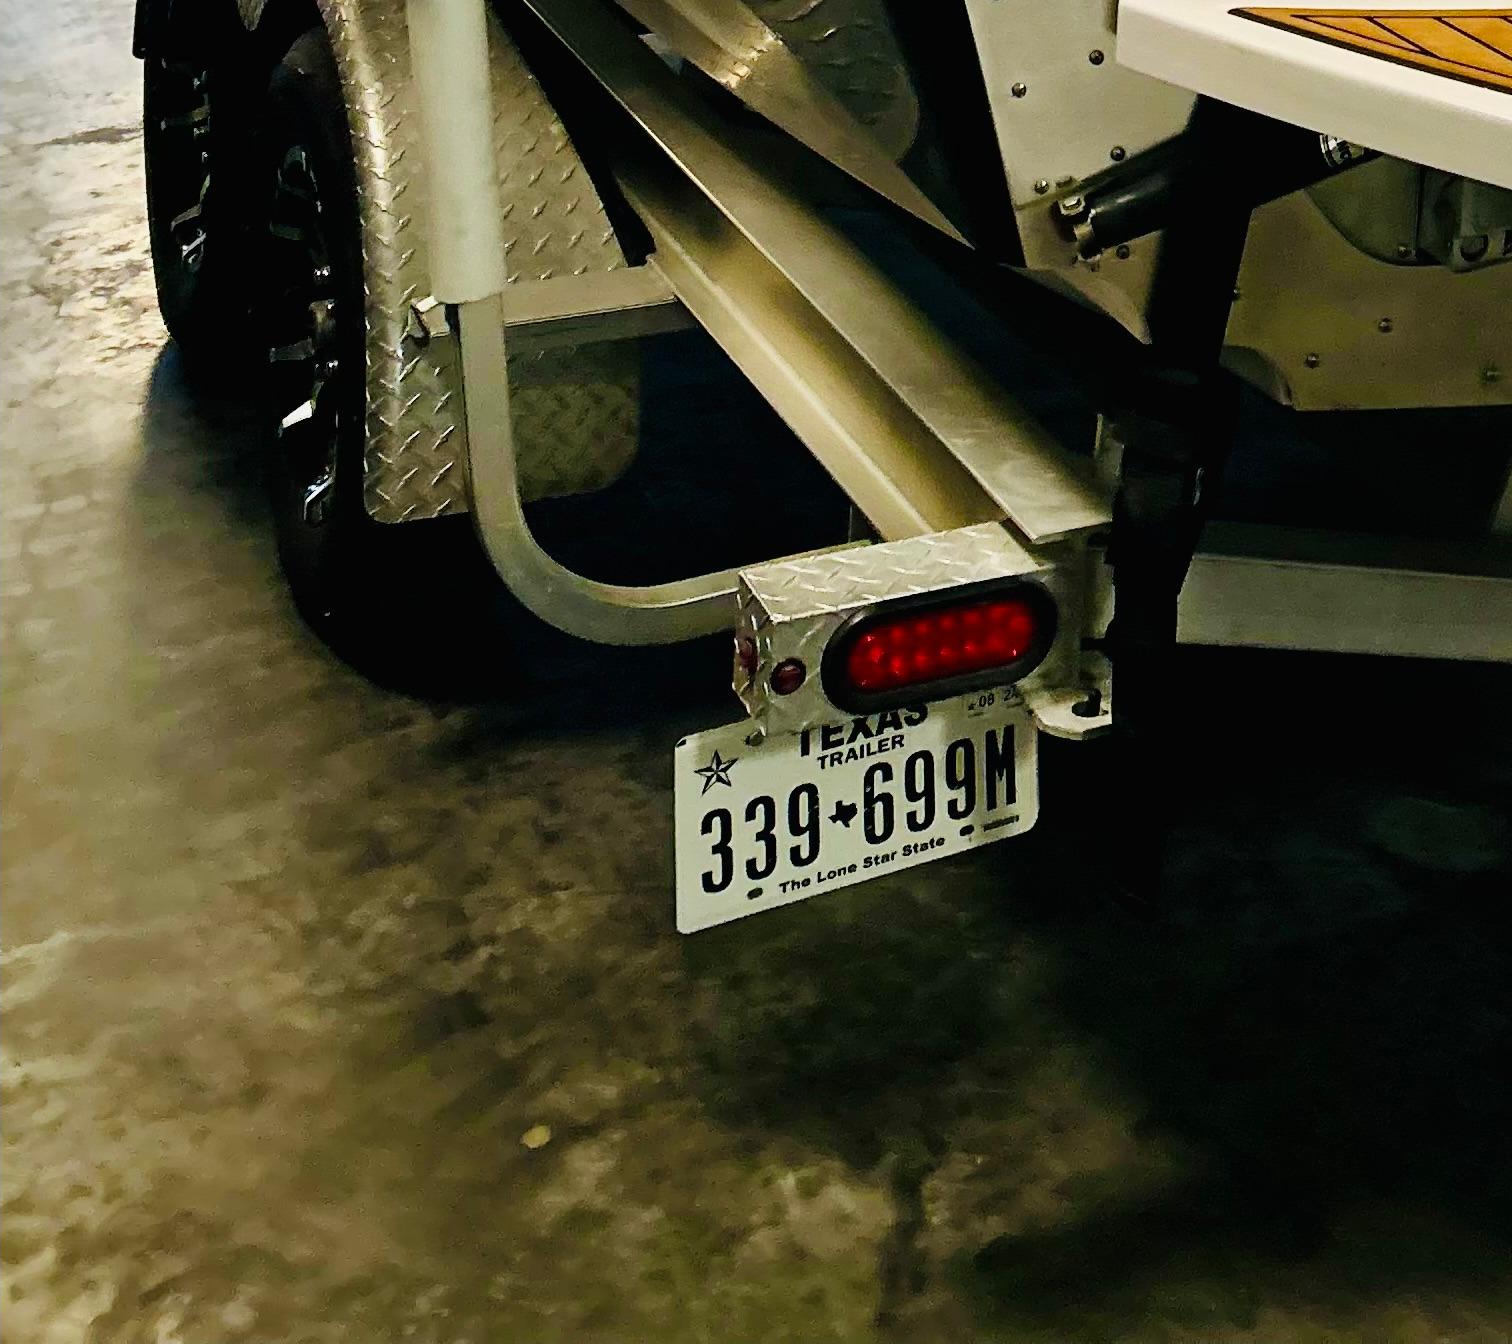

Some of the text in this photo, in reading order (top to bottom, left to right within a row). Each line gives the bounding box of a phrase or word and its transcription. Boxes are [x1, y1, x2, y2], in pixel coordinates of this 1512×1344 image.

[817, 733, 906, 770] TRAILER
[779, 836, 947, 894] The Lone Star State
